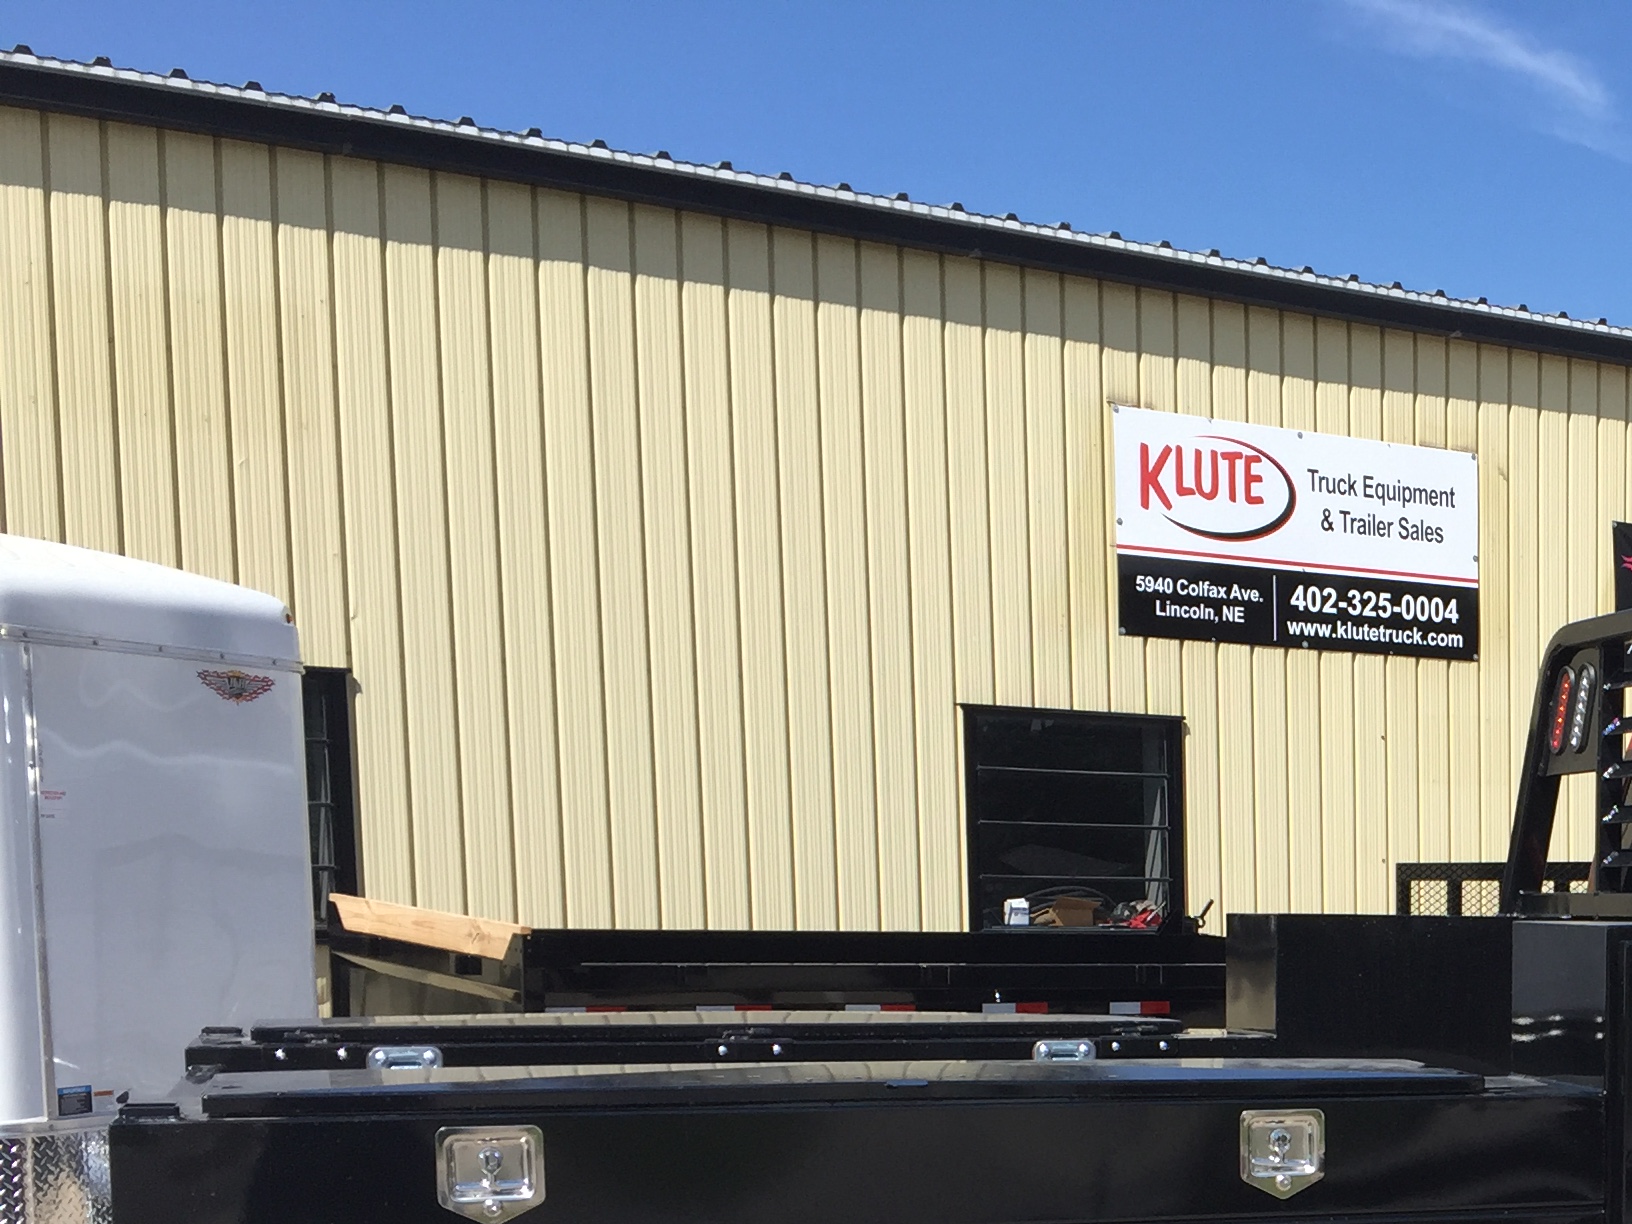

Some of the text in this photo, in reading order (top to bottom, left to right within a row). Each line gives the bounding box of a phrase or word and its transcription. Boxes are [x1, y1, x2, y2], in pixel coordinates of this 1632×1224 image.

[1140, 442, 1264, 511] KLUTE
[1307, 468, 1456, 509] Truck Equipment
[1321, 508, 1444, 544] & Trailer Sales
[1136, 575, 1263, 602] 5940 Colfax Ave.
[1290, 584, 1459, 624] 402-325-0004
[1155, 600, 1245, 624] Lincoln, NE
[1287, 618, 1463, 649] www.klutetruck.com
